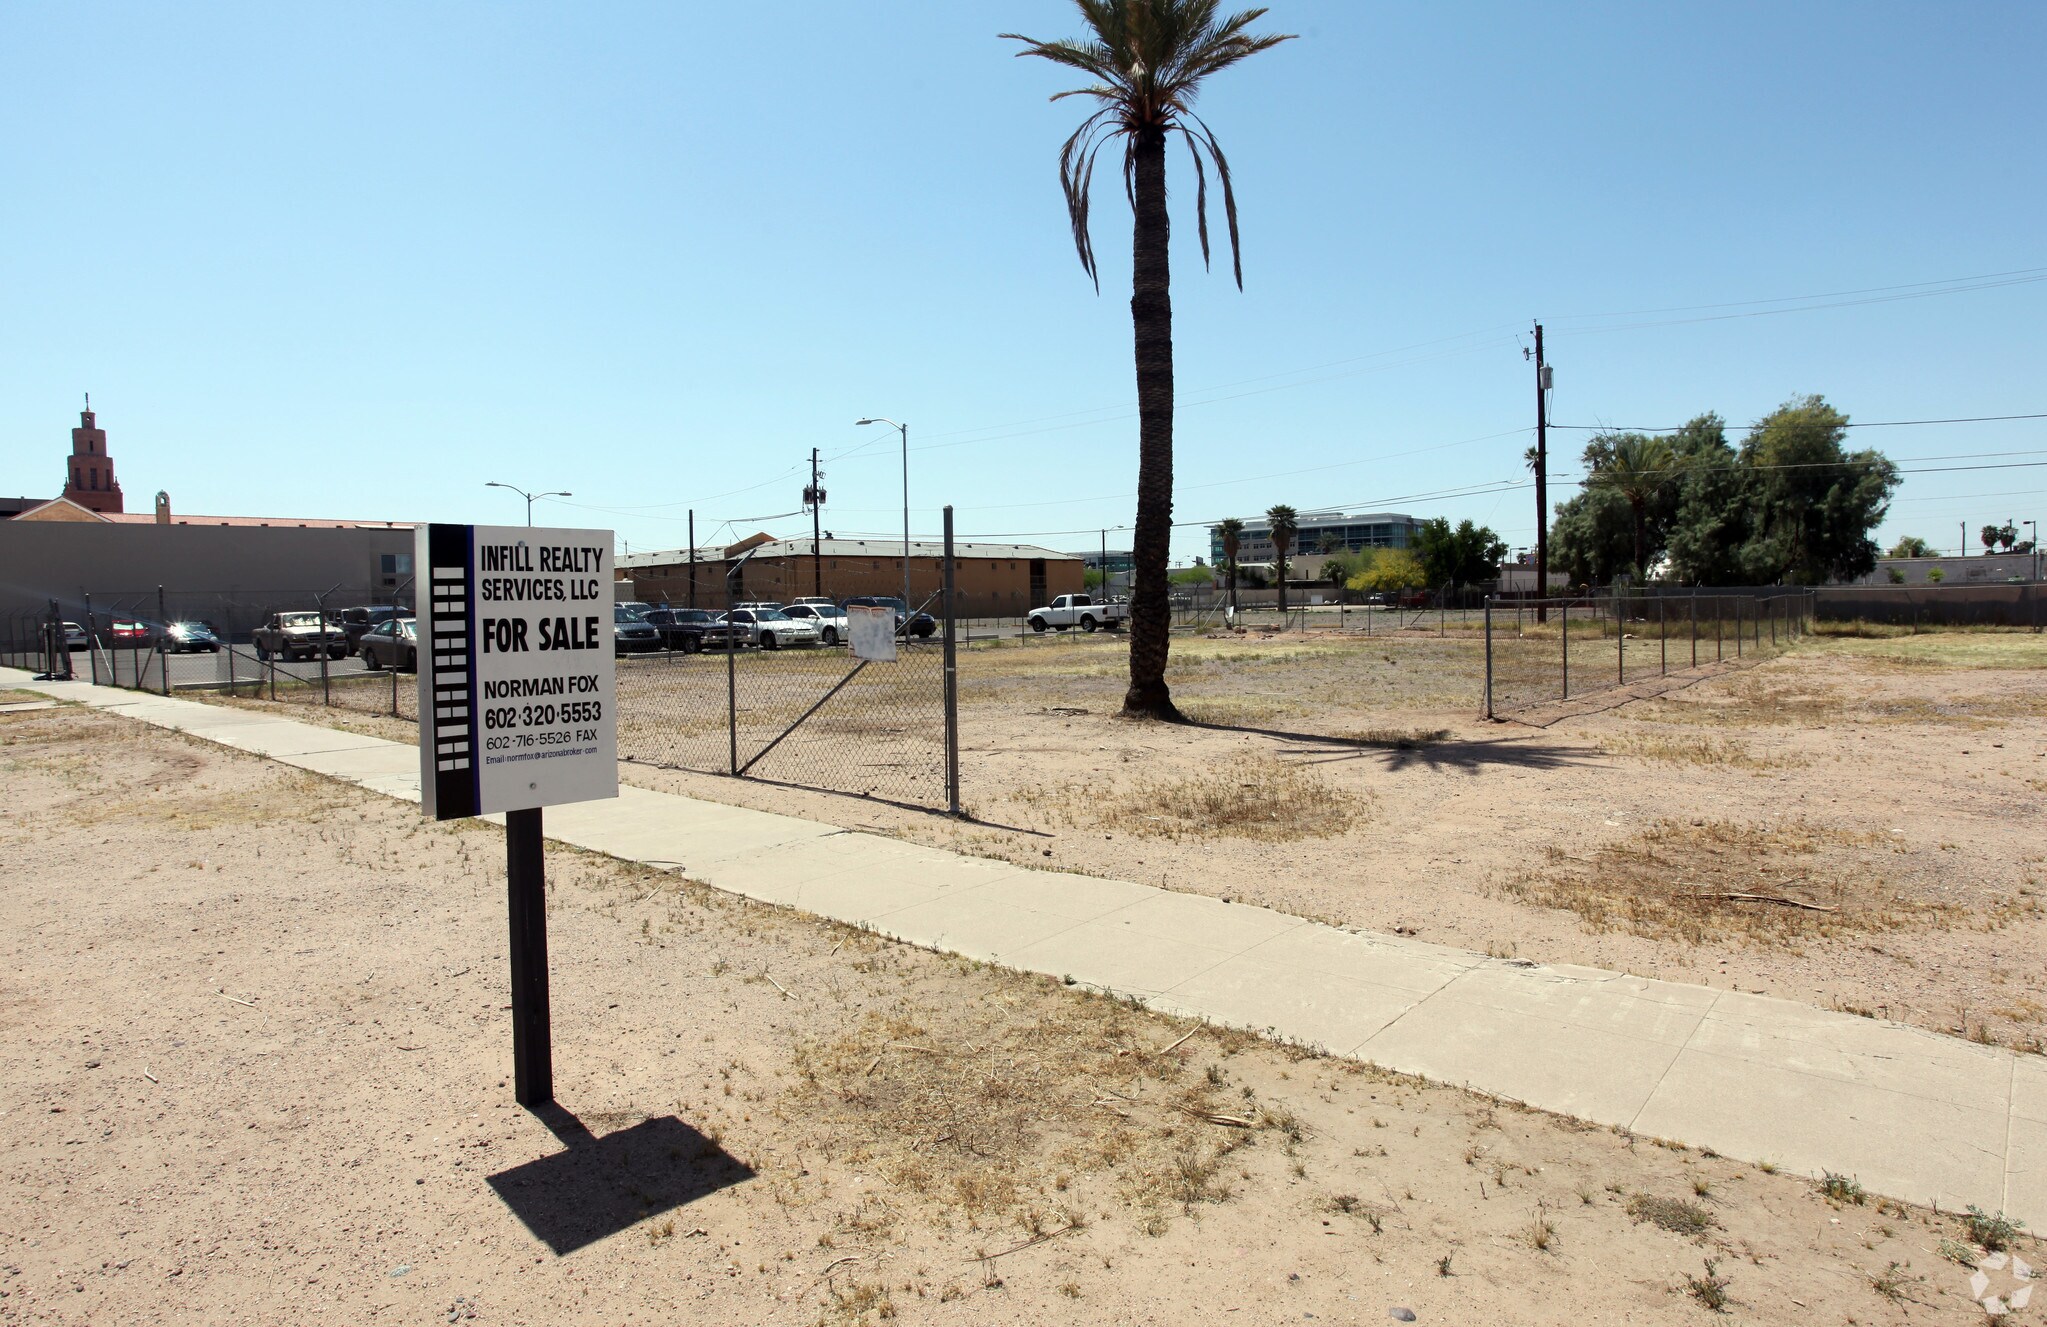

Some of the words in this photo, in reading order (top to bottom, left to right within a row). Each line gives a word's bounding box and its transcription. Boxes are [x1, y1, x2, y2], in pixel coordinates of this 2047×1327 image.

[481, 545, 534, 571] INFILL
[539, 546, 604, 573] REALTY
[481, 578, 567, 602] SERVICES,
[570, 579, 599, 600] LLC
[482, 617, 529, 653] FOR
[538, 616, 600, 651] SALE
[484, 676, 564, 699] NORMAN
[568, 674, 599, 693] FOX
[486, 731, 572, 750] 602-716-5526
[576, 728, 598, 742] FAX
